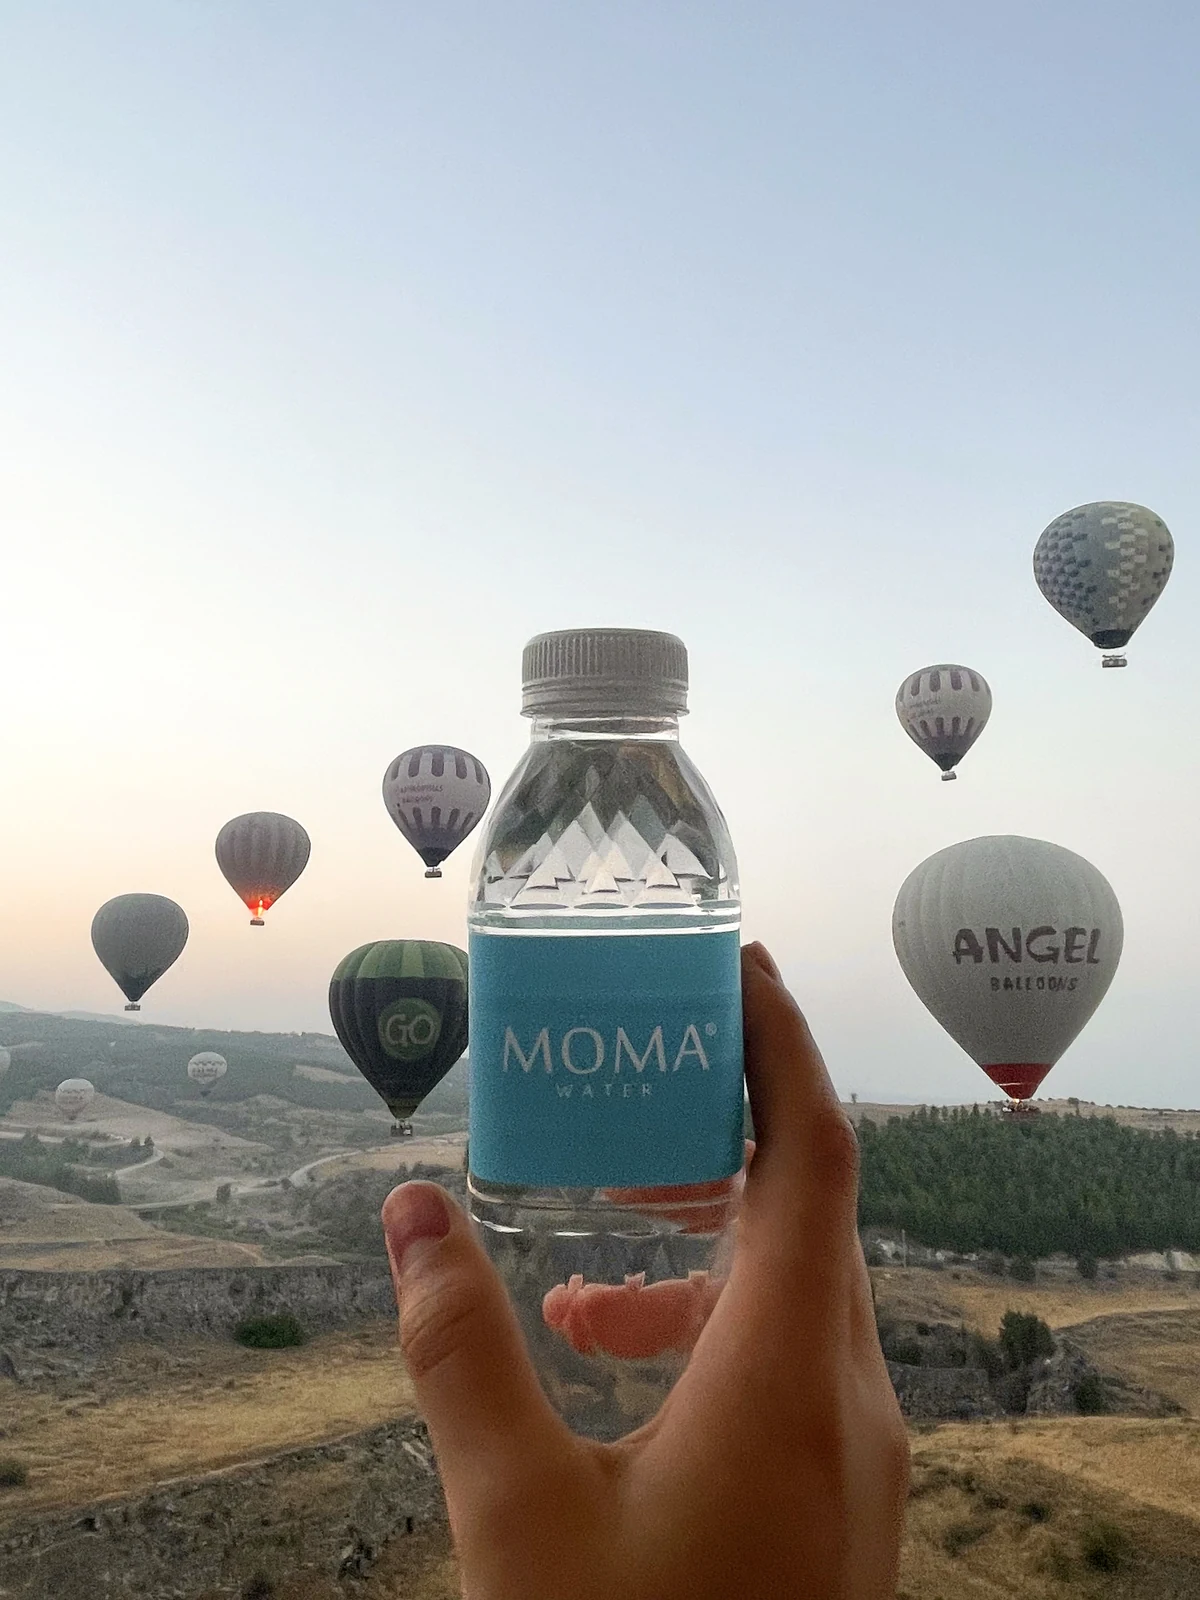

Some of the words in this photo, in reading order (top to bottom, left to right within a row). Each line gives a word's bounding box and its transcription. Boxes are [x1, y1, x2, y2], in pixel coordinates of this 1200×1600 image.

[952, 925, 1101, 965] ANGEL
[990, 976, 1078, 992] BALLOONS
[386, 1013, 435, 1048] GO
[555, 1082, 652, 1098] WATER
